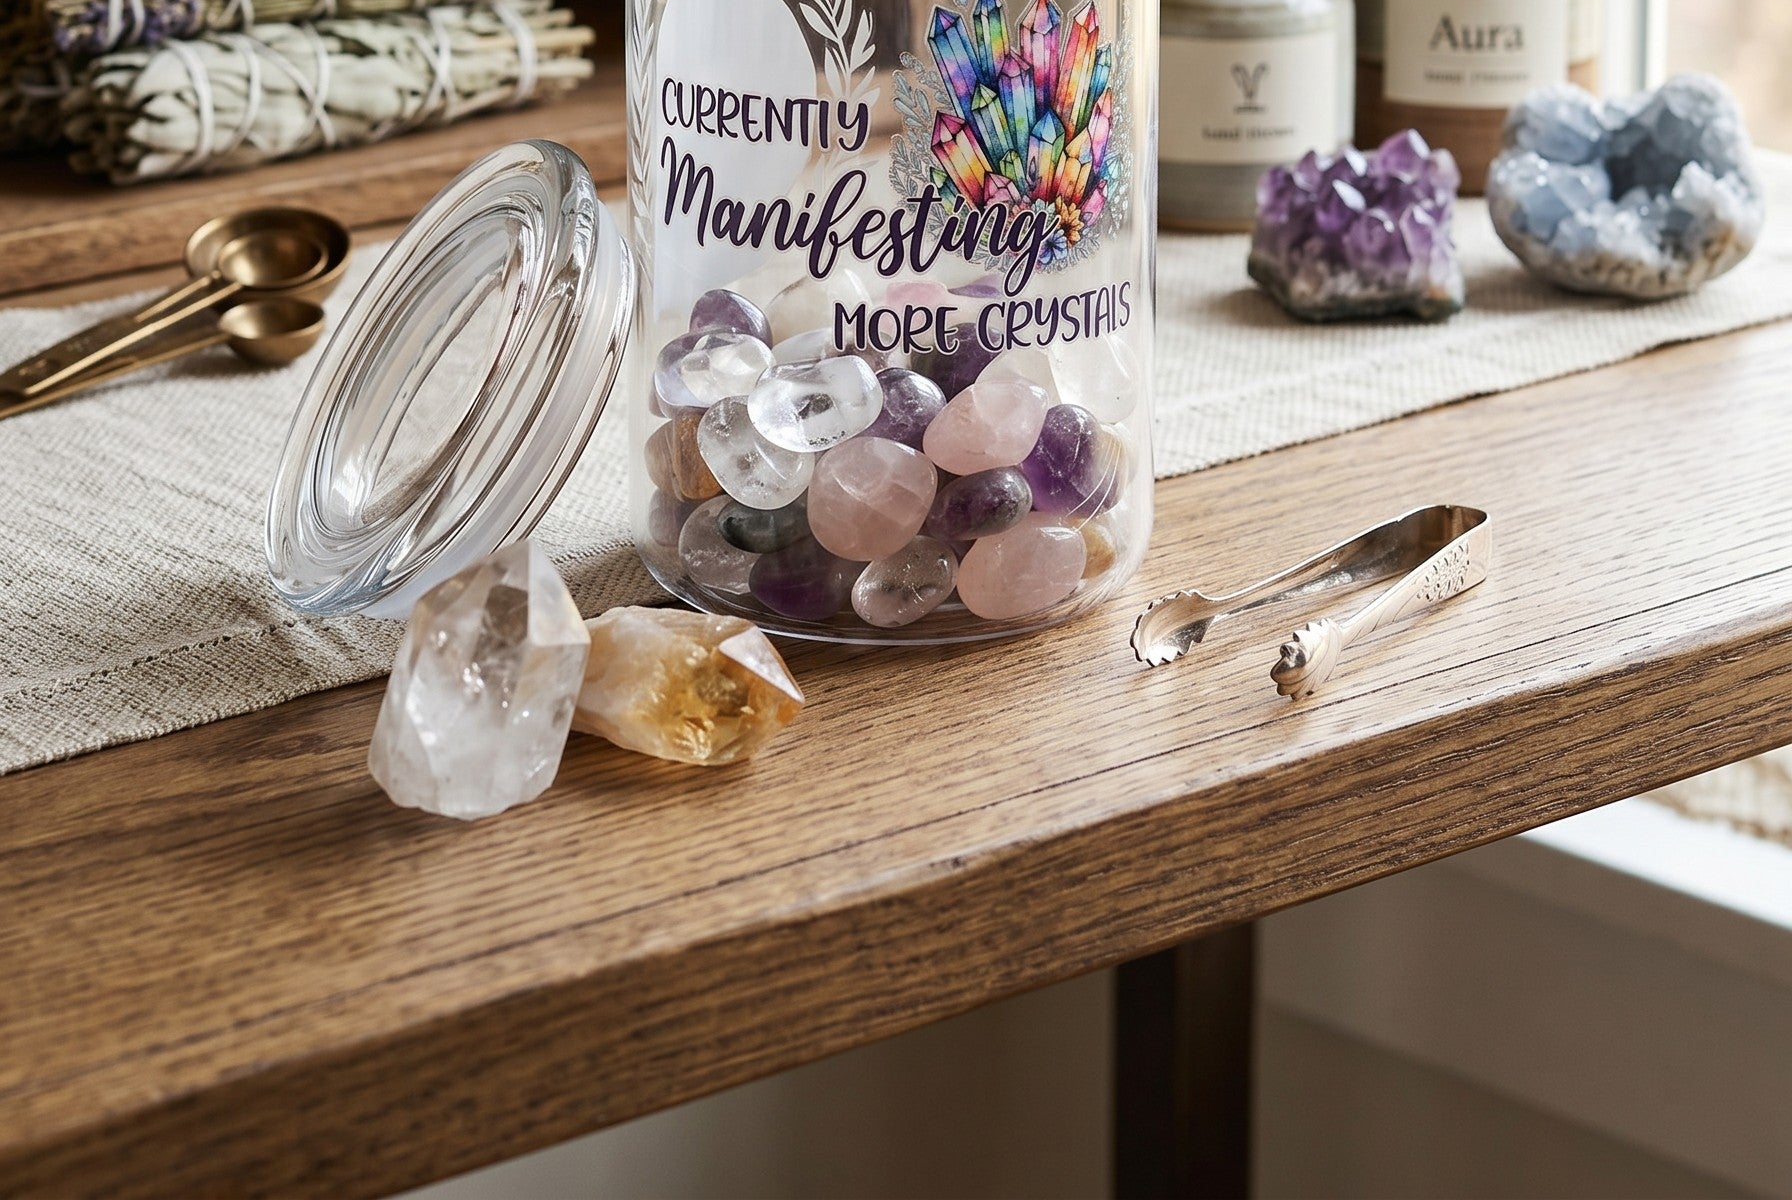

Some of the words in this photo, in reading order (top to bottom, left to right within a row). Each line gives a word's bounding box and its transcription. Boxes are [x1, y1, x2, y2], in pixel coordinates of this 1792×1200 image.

[1429, 14, 1525, 52] Aura
[661, 136, 1059, 296] Manifesting
[834, 302, 959, 354] MORE
[977, 281, 1131, 350] CRYSTALS
